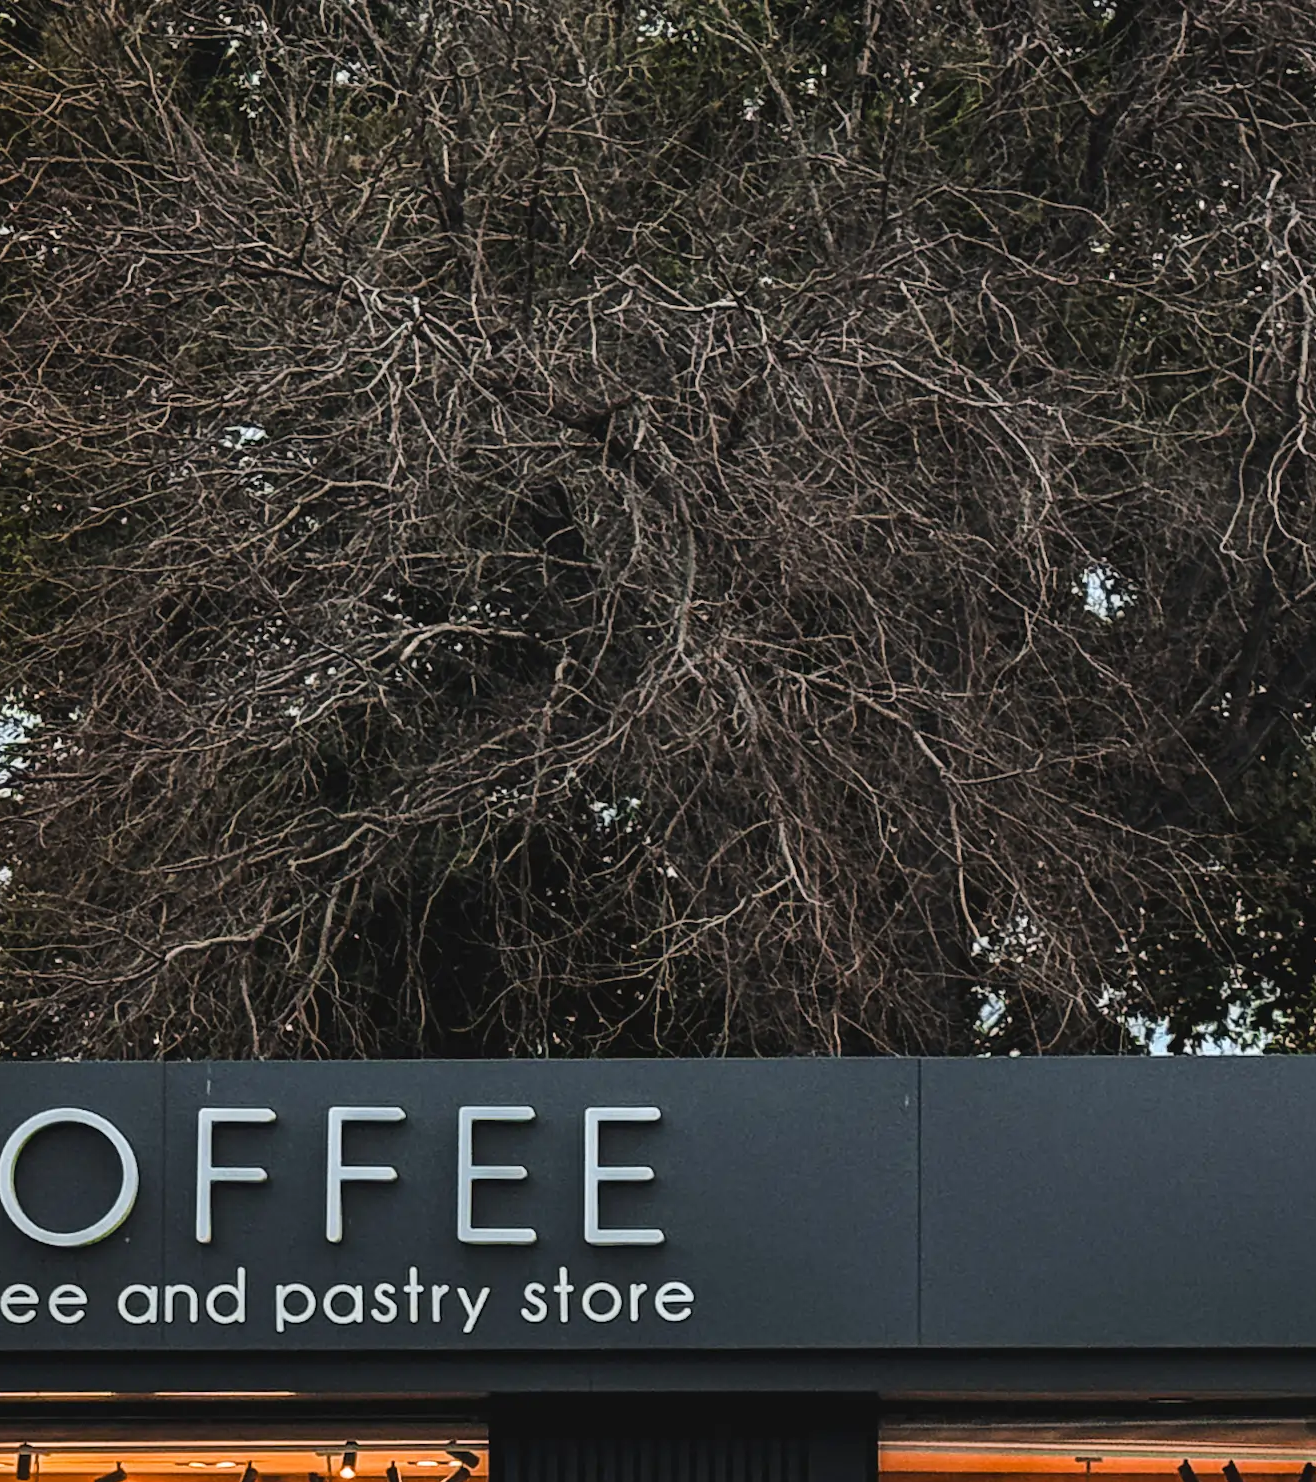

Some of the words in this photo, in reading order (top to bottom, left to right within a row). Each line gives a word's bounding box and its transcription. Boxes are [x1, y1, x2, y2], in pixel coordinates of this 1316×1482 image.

[117, 1266, 247, 1325] and
[275, 1266, 491, 1334] pastry
[520, 1269, 695, 1324] store
